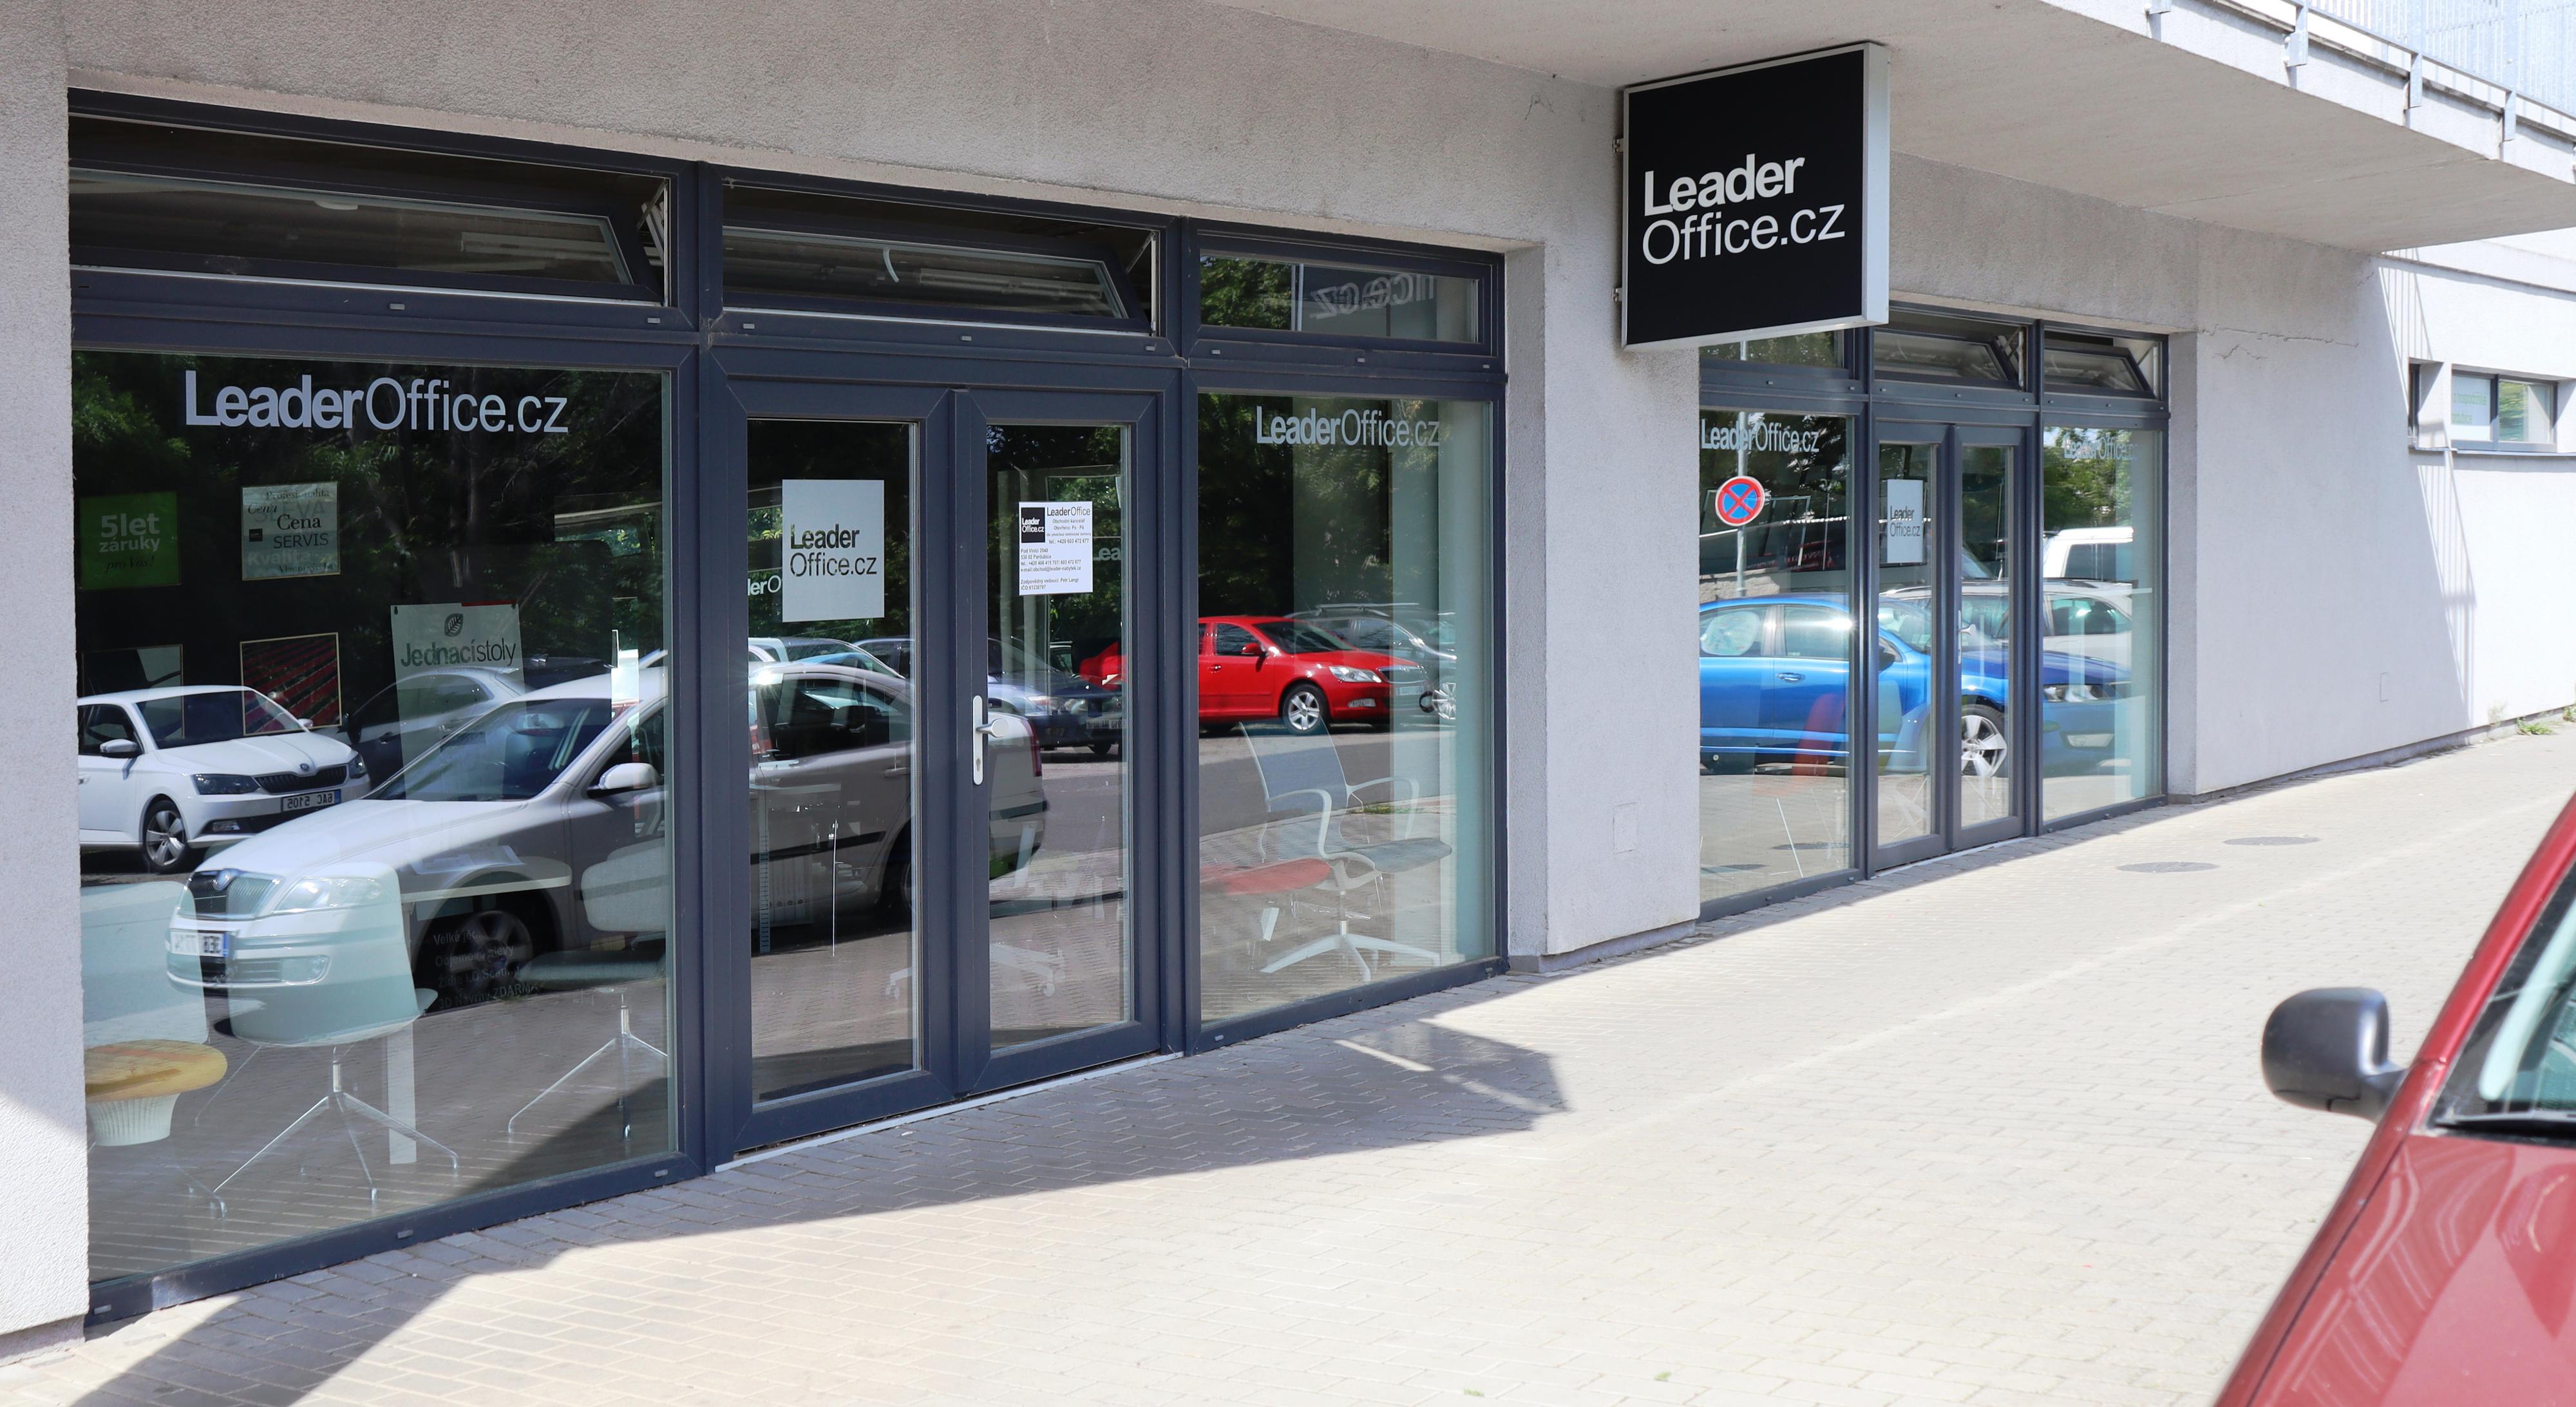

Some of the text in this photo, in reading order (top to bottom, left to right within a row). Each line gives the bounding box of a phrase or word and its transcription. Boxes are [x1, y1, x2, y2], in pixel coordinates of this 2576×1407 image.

[1644, 153, 1806, 216] Leader
[1642, 204, 1845, 265] Office.cz
[185, 370, 569, 433] LeaderOffice.cz
[1256, 406, 1440, 448] LeaderOffice.cz
[1701, 418, 1819, 452] LeaderOffice.cz
[1021, 517, 1040, 525] Leader
[1046, 506, 1091, 516] LeaderOffice
[1889, 505, 1915, 520] Leader
[277, 514, 321, 531] Cena
[1889, 522, 1921, 537] Office.cz
[99, 535, 161, 553] záruky
[274, 533, 329, 549] SERVIS
[790, 524, 860, 549] Leader
[790, 552, 877, 577] Office.cz
